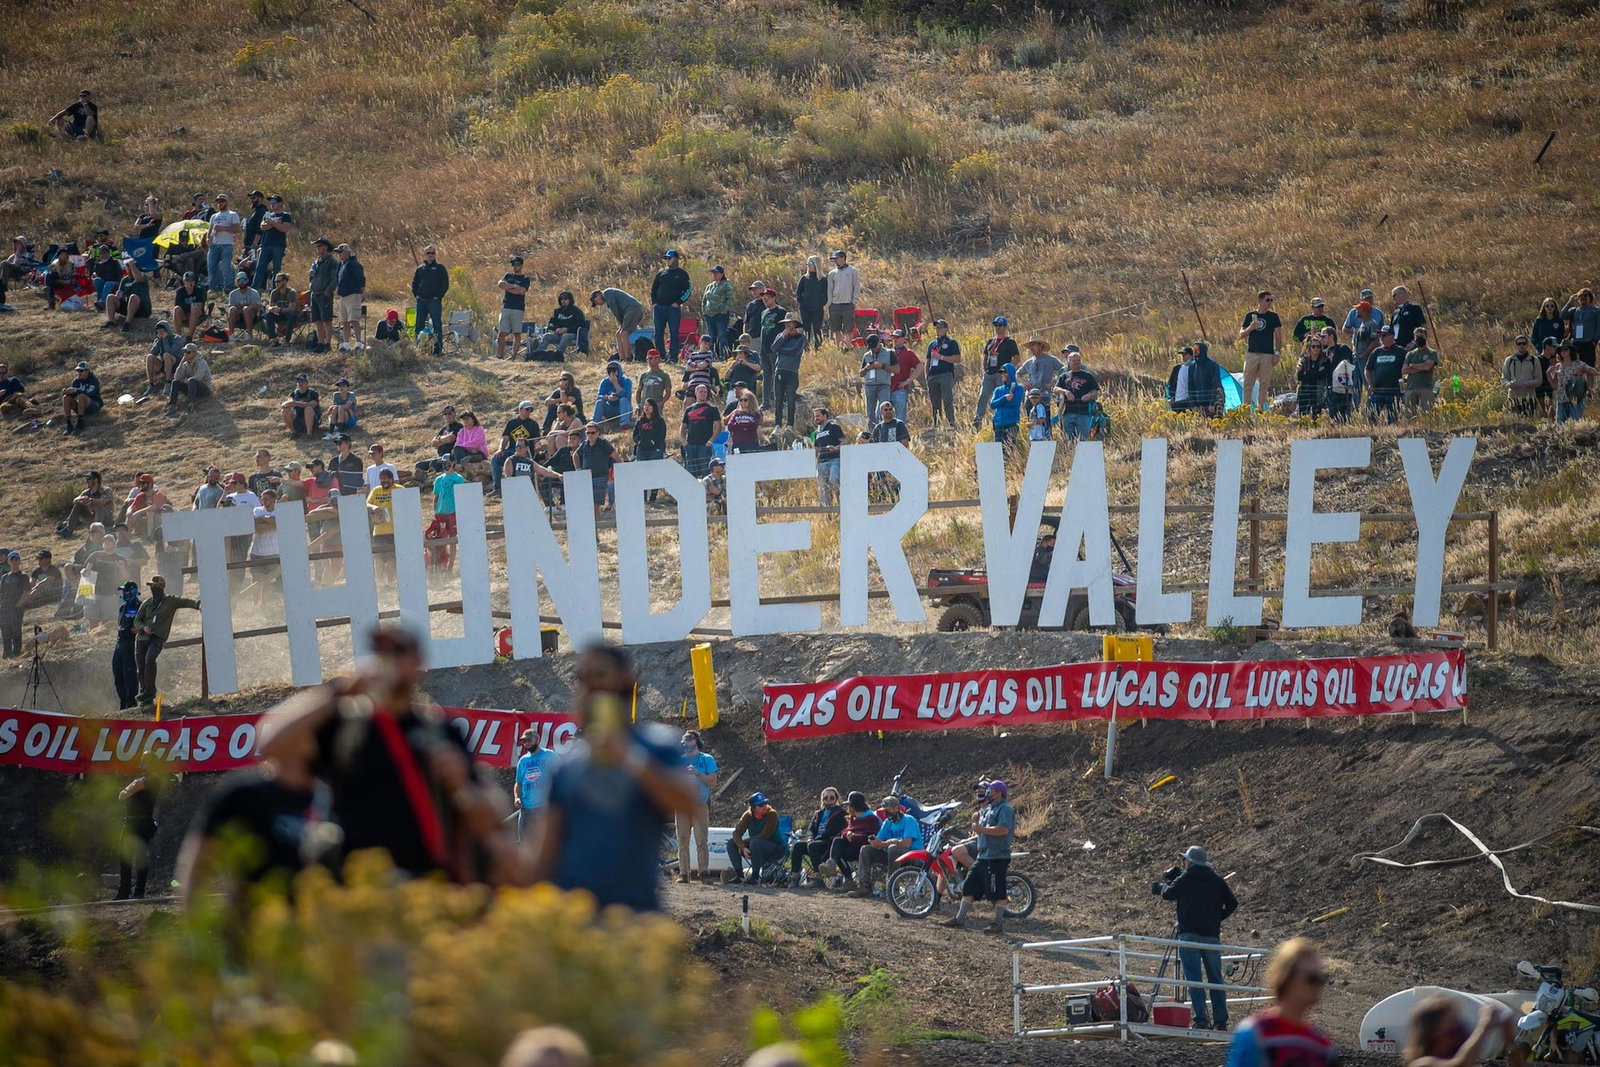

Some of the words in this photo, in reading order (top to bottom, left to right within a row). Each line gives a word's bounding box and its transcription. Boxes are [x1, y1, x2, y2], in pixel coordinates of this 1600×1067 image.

[515, 462, 532, 472] FOX
[162, 441, 930, 695] THUNDER
[975, 436, 1477, 629] VALLEY
[764, 689, 838, 731] CAS
[846, 683, 902, 722] OIL
[916, 677, 1018, 720] LUCAS
[1026, 674, 1068, 713] OIL
[1081, 670, 1180, 709] LUCAS
[1187, 671, 1233, 709] OIL
[1244, 667, 1319, 709] LUCAS
[1324, 666, 1358, 706] OIL
[1369, 660, 1450, 704] LUCAS
[23, 722, 80, 761] OIL
[91, 724, 220, 763] LUCAS
